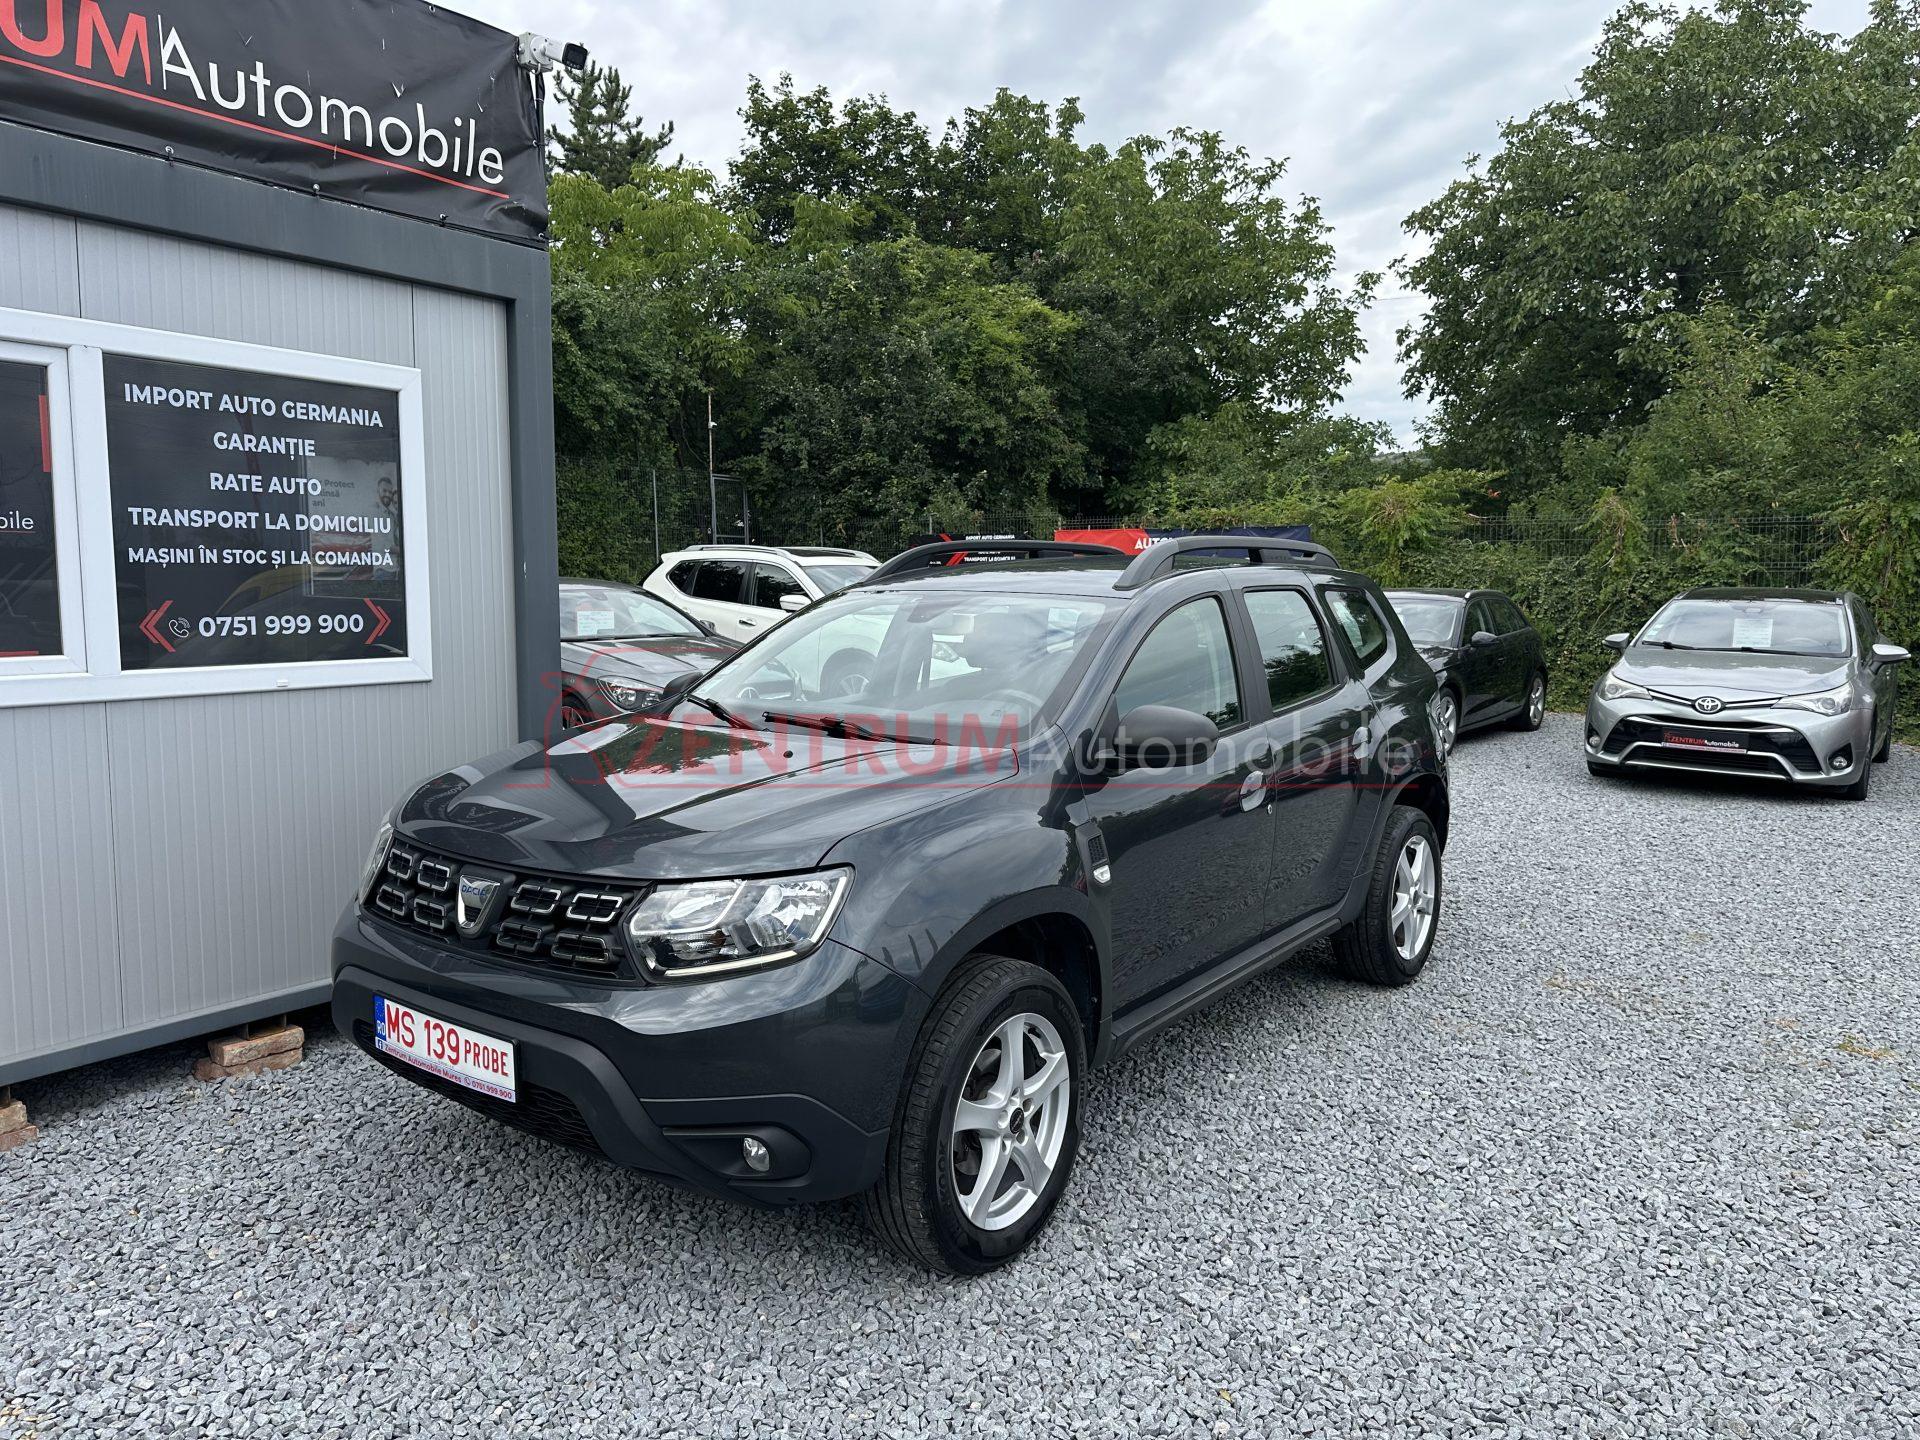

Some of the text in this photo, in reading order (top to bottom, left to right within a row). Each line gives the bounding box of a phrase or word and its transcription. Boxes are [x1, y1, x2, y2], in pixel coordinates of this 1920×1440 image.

[160, 26, 504, 184] Automobile
[124, 383, 384, 427] IMPORT AUTO GERMANIA
[213, 431, 316, 460] GARANȚIE
[209, 472, 322, 496] RATE AUTO
[128, 507, 391, 533] TRANSPORT LA DOMICILIU
[128, 544, 393, 569] MAȘINI ÎN STOC ȘI LA COMANDĂ
[198, 614, 364, 637] 0751 999 900
[387, 1004, 415, 1048] MS
[424, 1019, 460, 1065] 139
[464, 1039, 509, 1077] PROBE
[408, 1055, 445, 1075] Automobile
